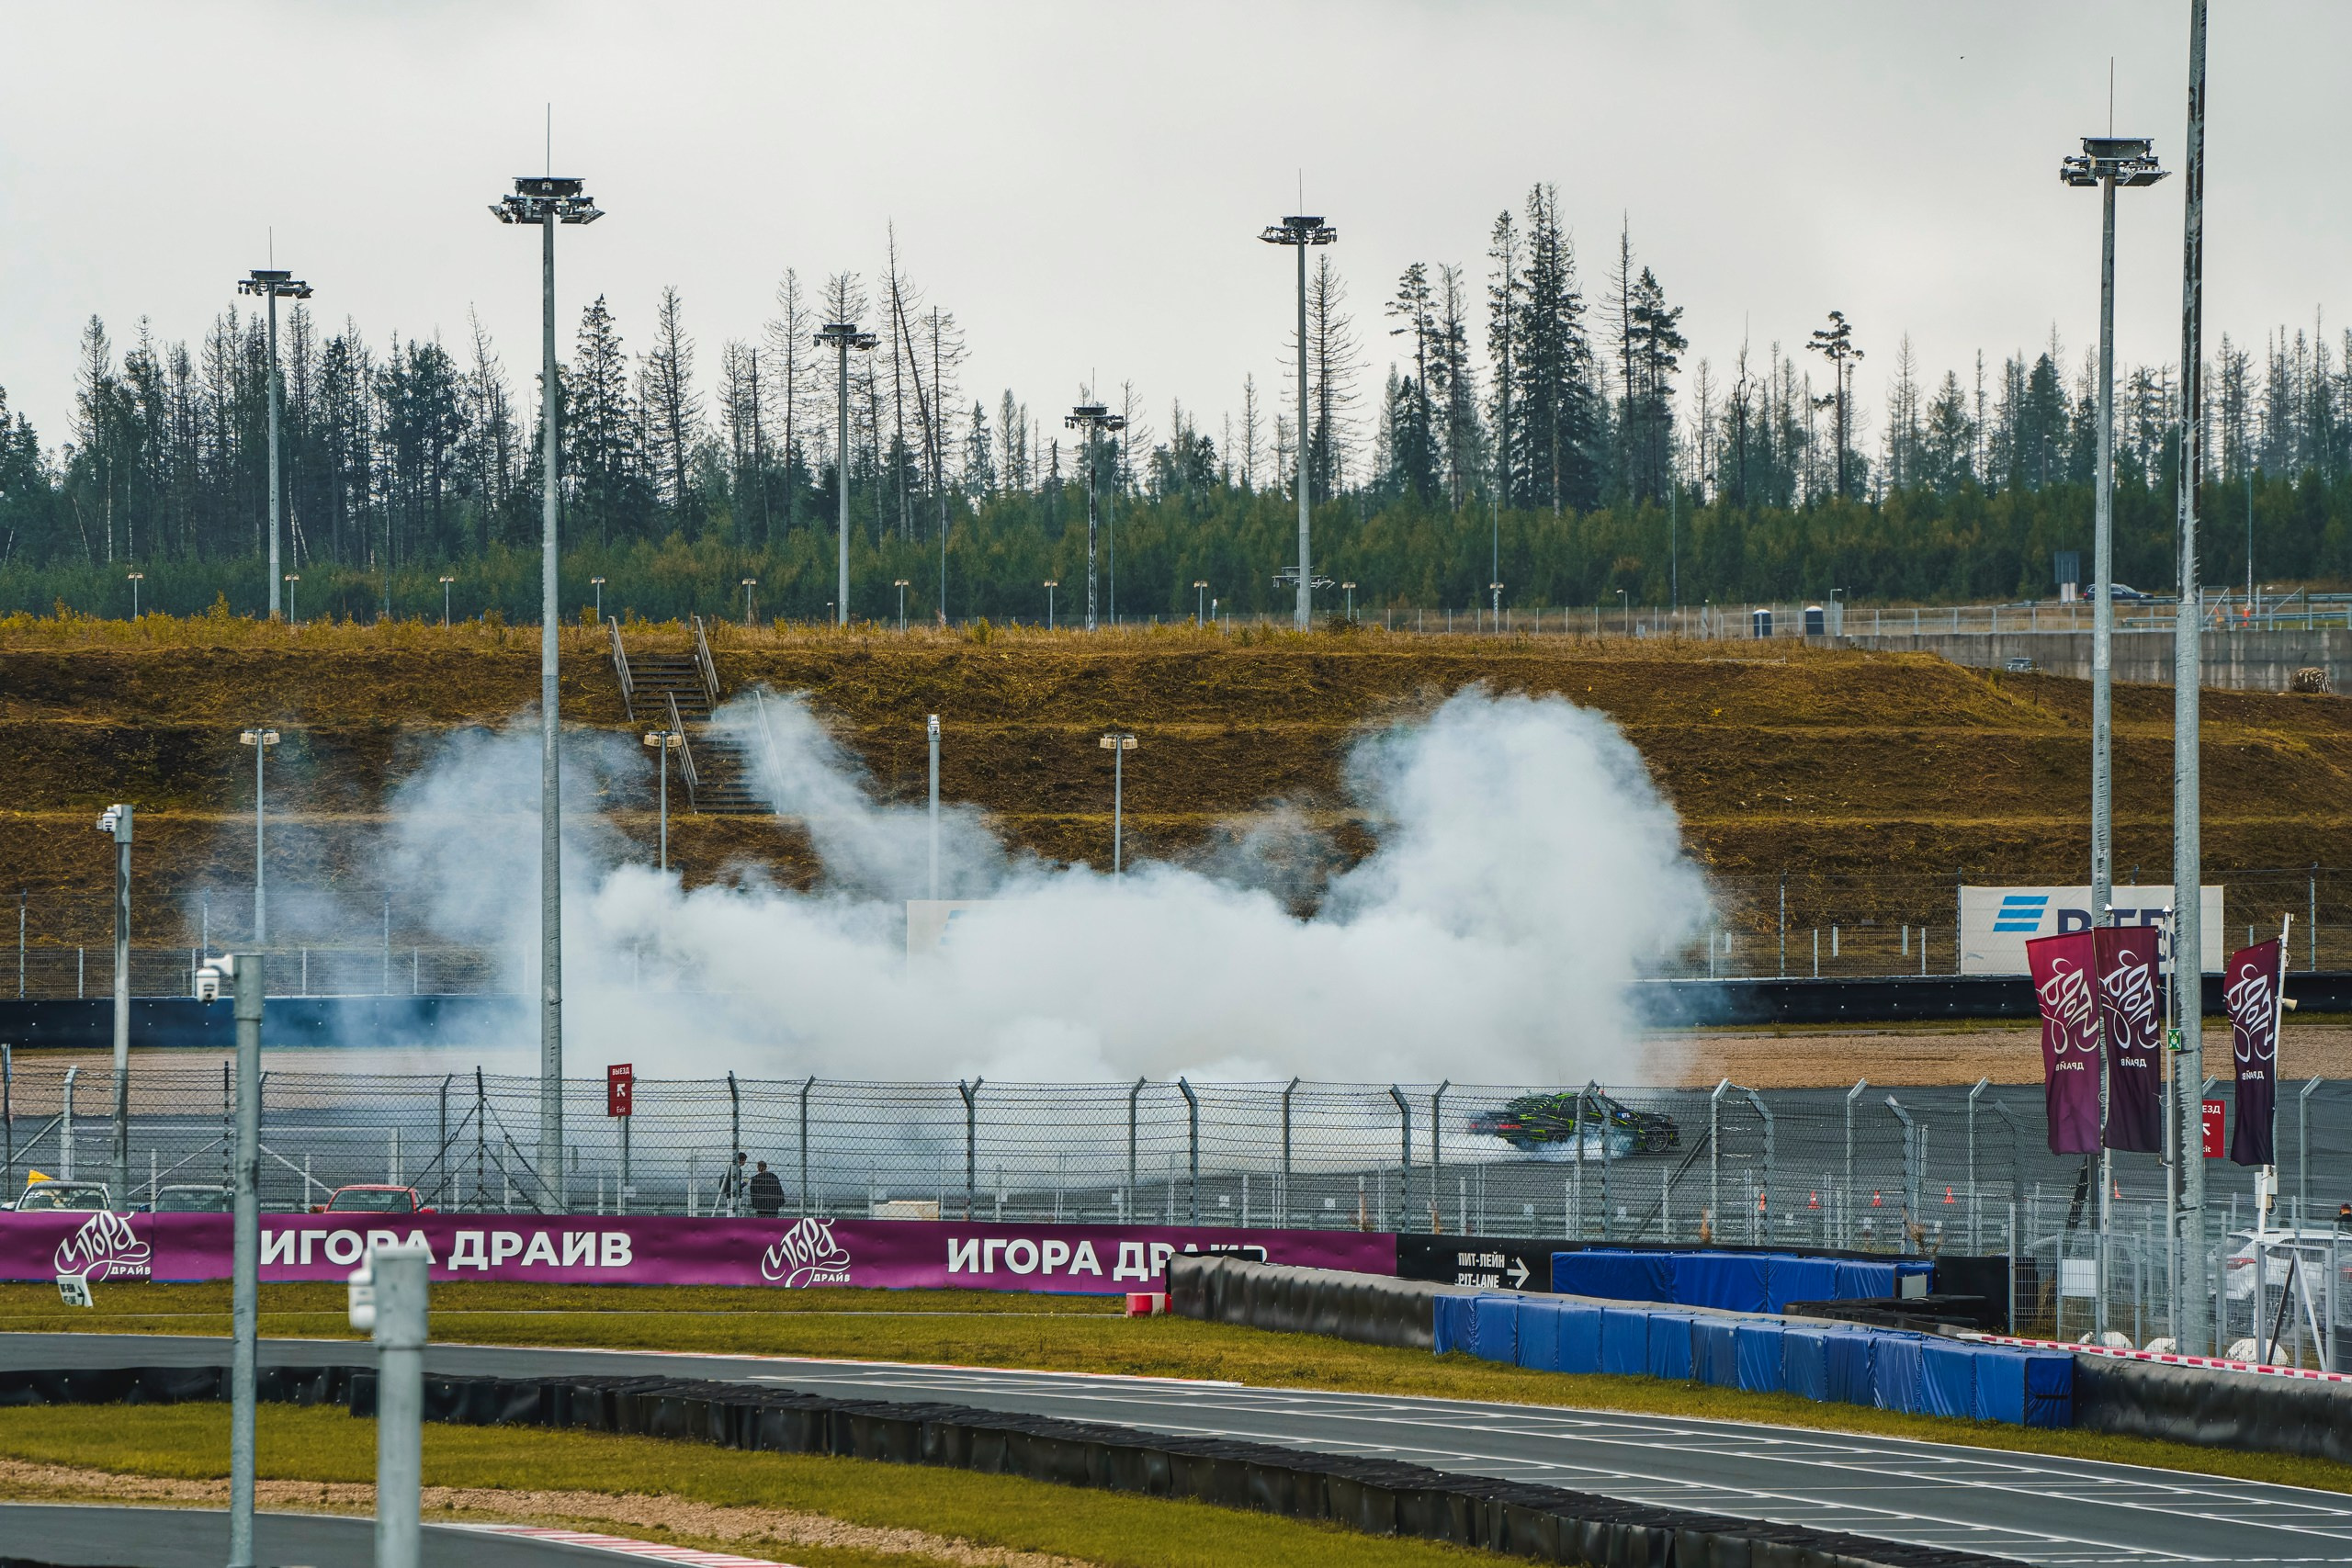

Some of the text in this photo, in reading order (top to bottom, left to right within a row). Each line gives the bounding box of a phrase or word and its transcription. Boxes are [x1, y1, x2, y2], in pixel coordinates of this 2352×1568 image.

[612, 1066, 630, 1076] ВЫЕЗД
[616, 1105, 626, 1113] Exit
[2202, 1105, 2221, 1114] ЕЗД
[447, 1231, 632, 1270] ДРАЙВ
[947, 1238, 1102, 1276] ИГОРА
[1458, 1251, 1505, 1269] ПИТ-ЛЕЙН
[110, 1265, 151, 1275] ДРАЙВ
[813, 1272, 851, 1282] ДРАЙВ
[1458, 1272, 1499, 1289] PIT-LANE
